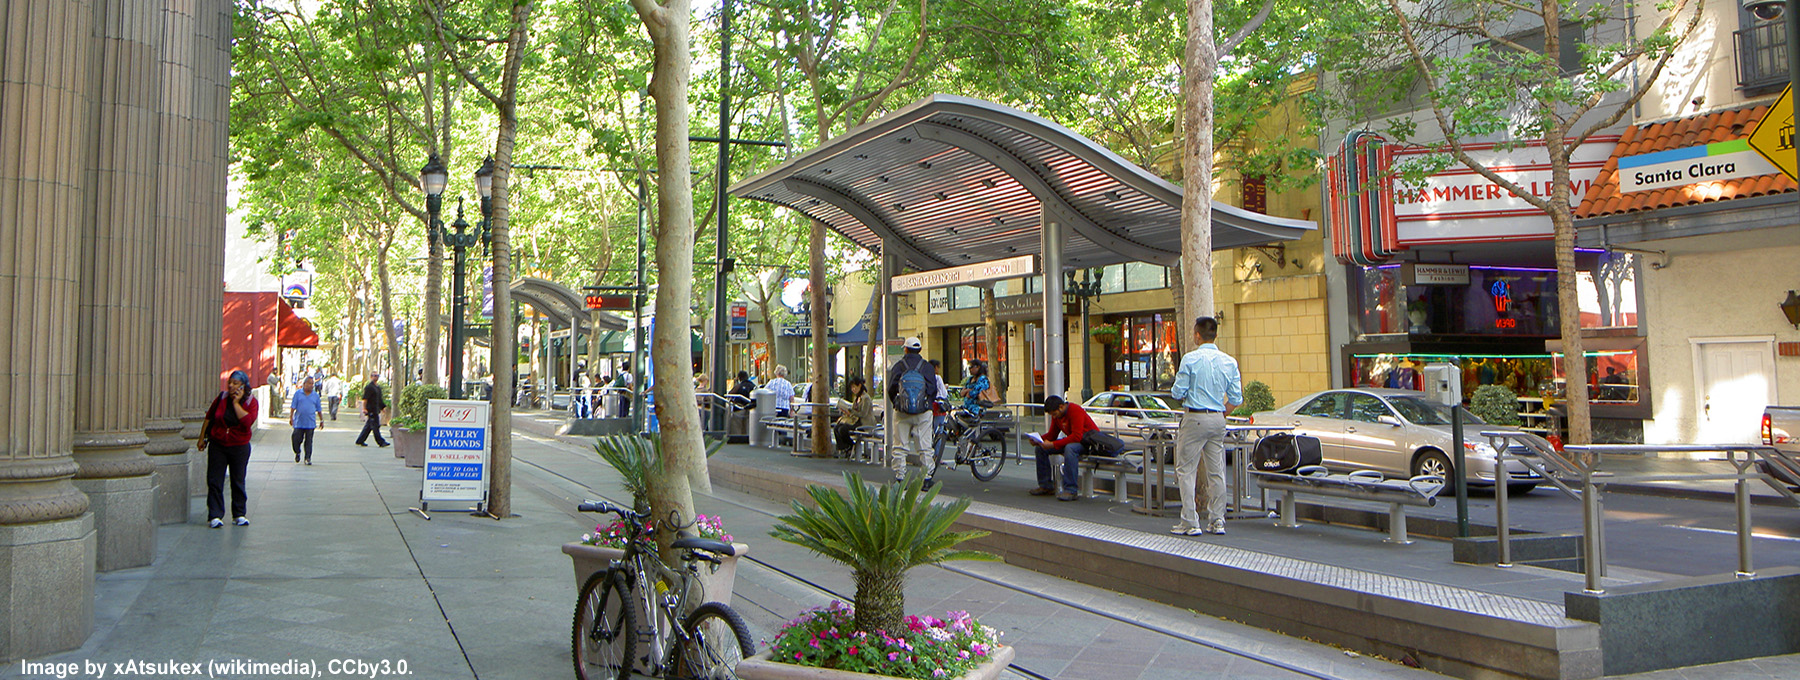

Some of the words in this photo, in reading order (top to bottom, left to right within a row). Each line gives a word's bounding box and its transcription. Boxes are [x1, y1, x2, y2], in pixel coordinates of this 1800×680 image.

[1634, 168, 1683, 185] Santa
[1688, 162, 1736, 178] Clara
[1398, 184, 1501, 205] HAMMER
[1531, 180, 1591, 197] LEWI
[940, 271, 960, 284] NORTH
[1016, 297, 1043, 309] Galler
[433, 430, 478, 438] JEWELRY
[431, 439, 480, 448] DIAMONDS
